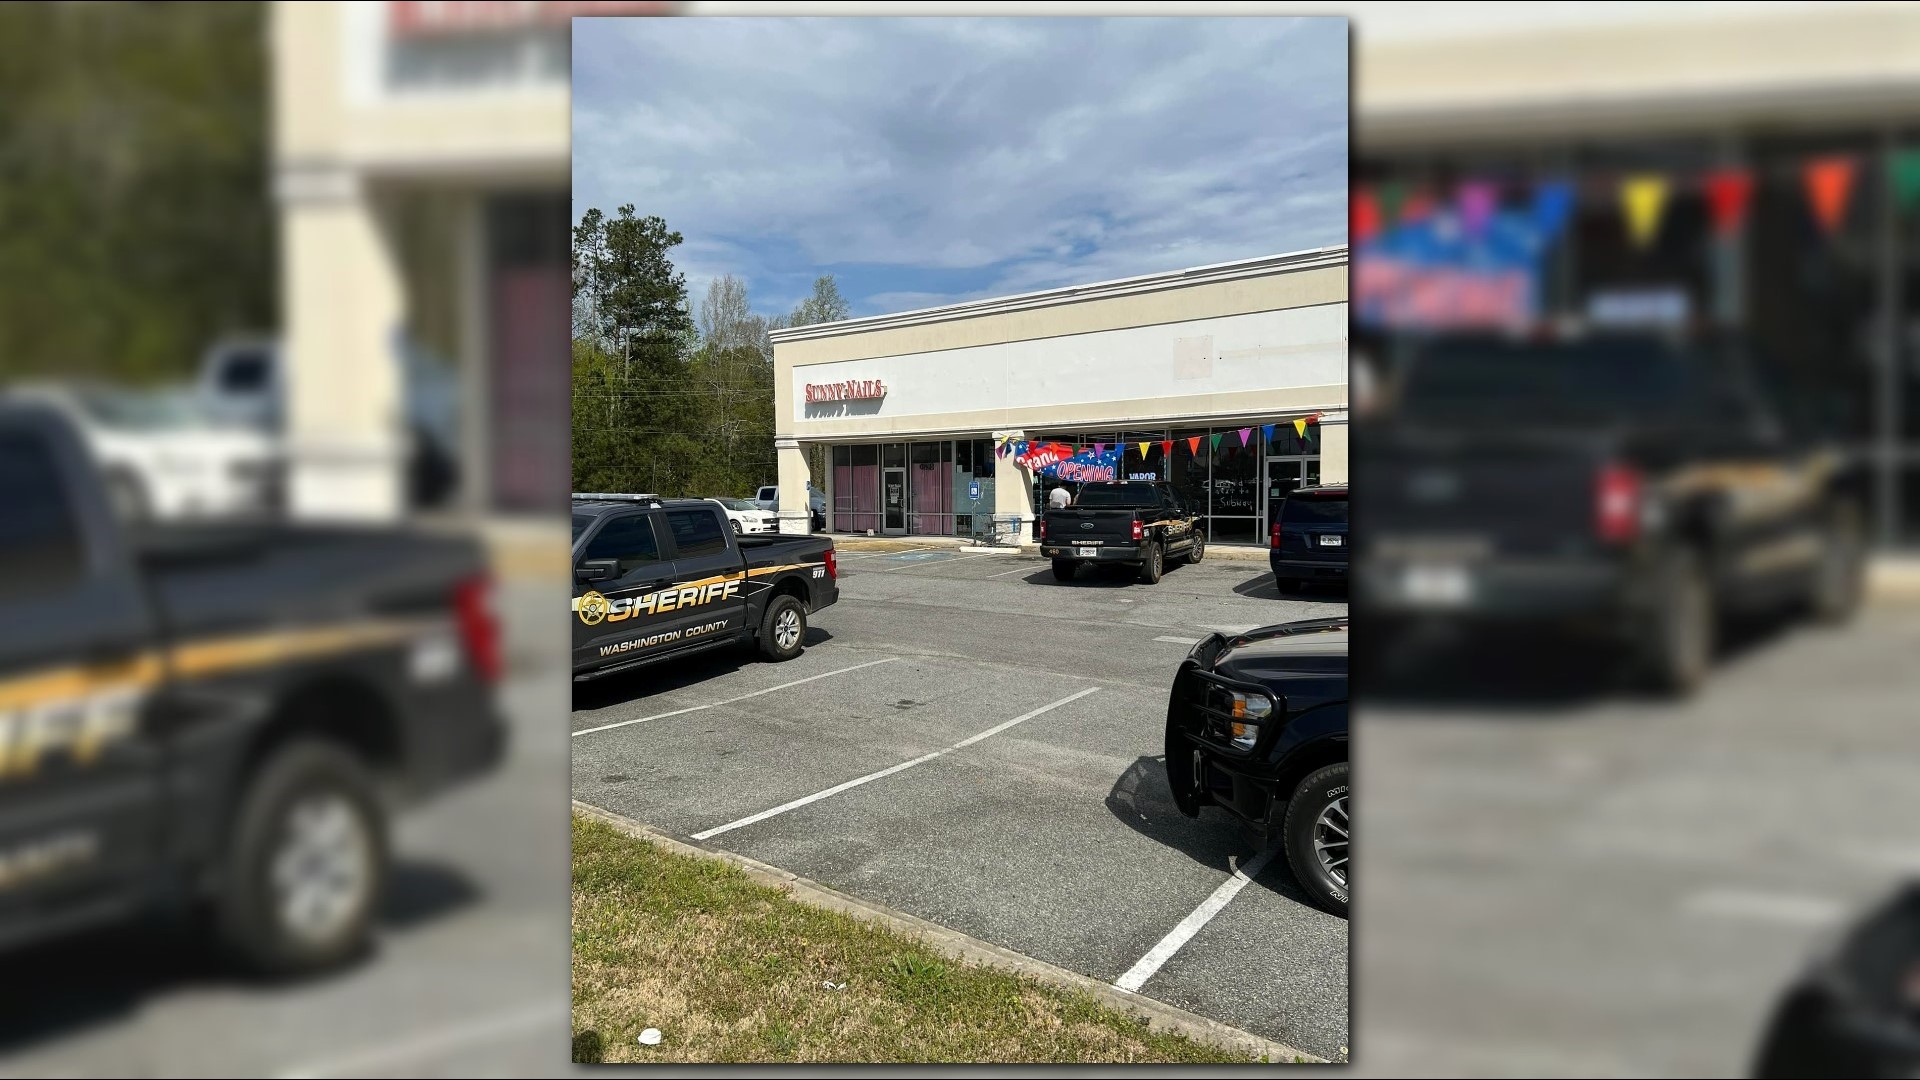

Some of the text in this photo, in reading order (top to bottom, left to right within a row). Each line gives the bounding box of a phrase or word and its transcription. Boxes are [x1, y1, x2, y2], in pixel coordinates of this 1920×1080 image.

[805, 380, 881, 402] SUNNY NAILS
[1056, 460, 1114, 482] OPENING
[812, 569, 825, 578] 911
[607, 579, 741, 623] SHERIFF
[599, 619, 729, 657] WASHINGTON COUNTY
